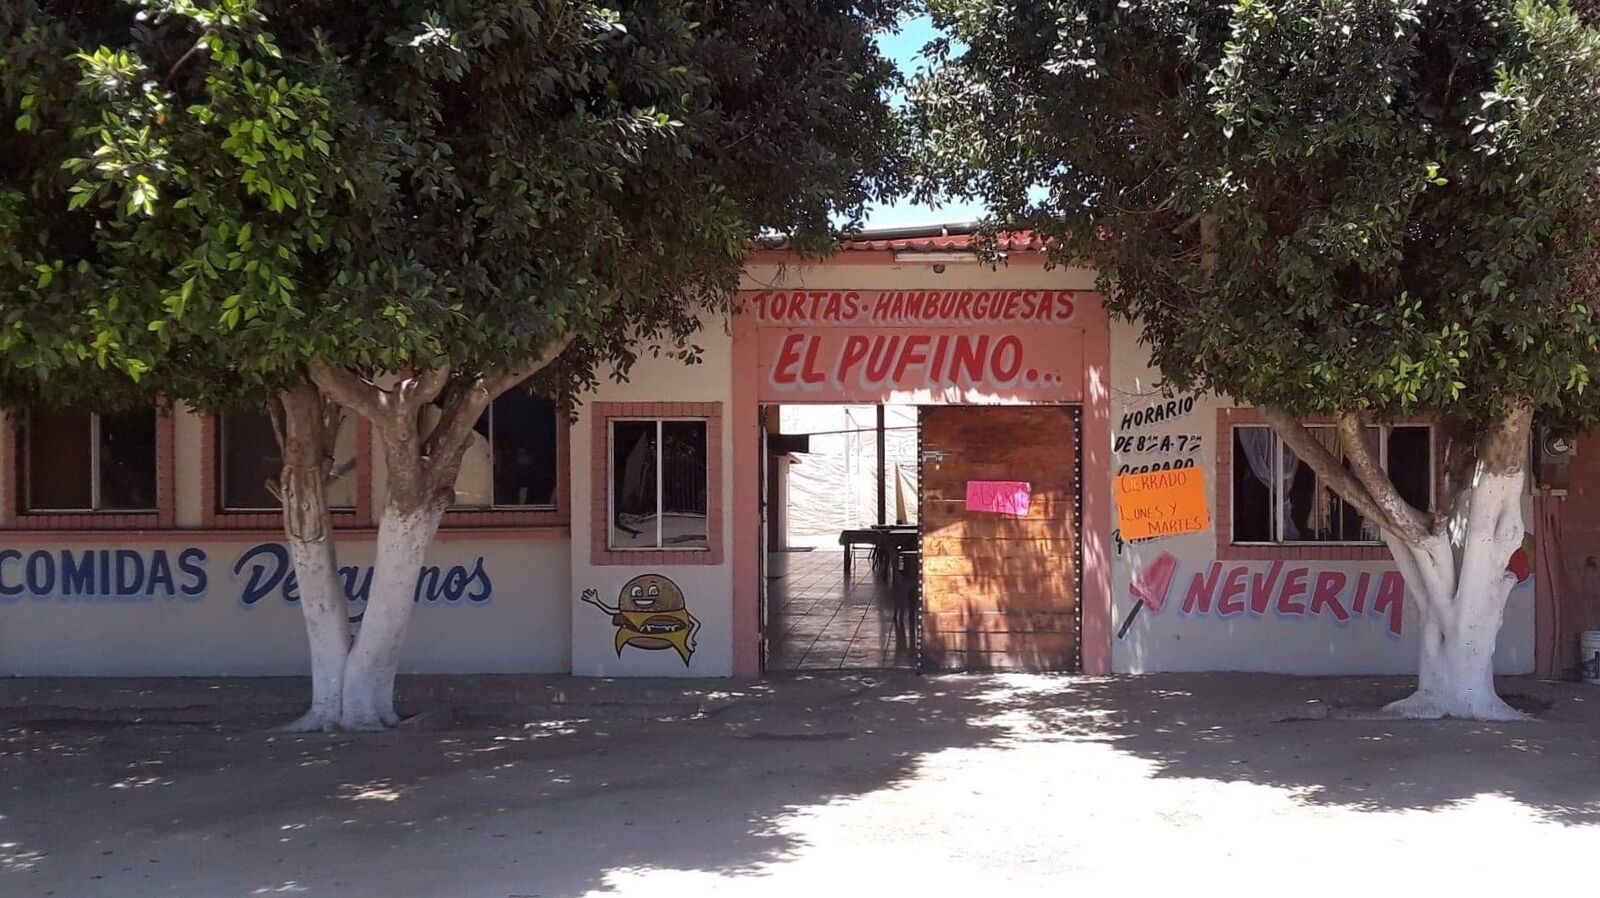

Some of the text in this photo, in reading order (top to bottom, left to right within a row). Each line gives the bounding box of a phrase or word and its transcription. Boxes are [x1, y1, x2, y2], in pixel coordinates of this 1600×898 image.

[752, 291, 860, 321] TORTAS
[871, 289, 1074, 320] HAMBURGUESAS
[774, 333, 825, 384] EL
[1120, 396, 1194, 431] HORARIO
[1114, 436, 1134, 453] DE
[1121, 472, 1187, 494] CERRADO
[1119, 502, 1177, 521] LUNES Y
[1148, 515, 1203, 535] MARTES
[0, 547, 208, 596] COMIDAS
[1181, 560, 1405, 636] NEVERIA
